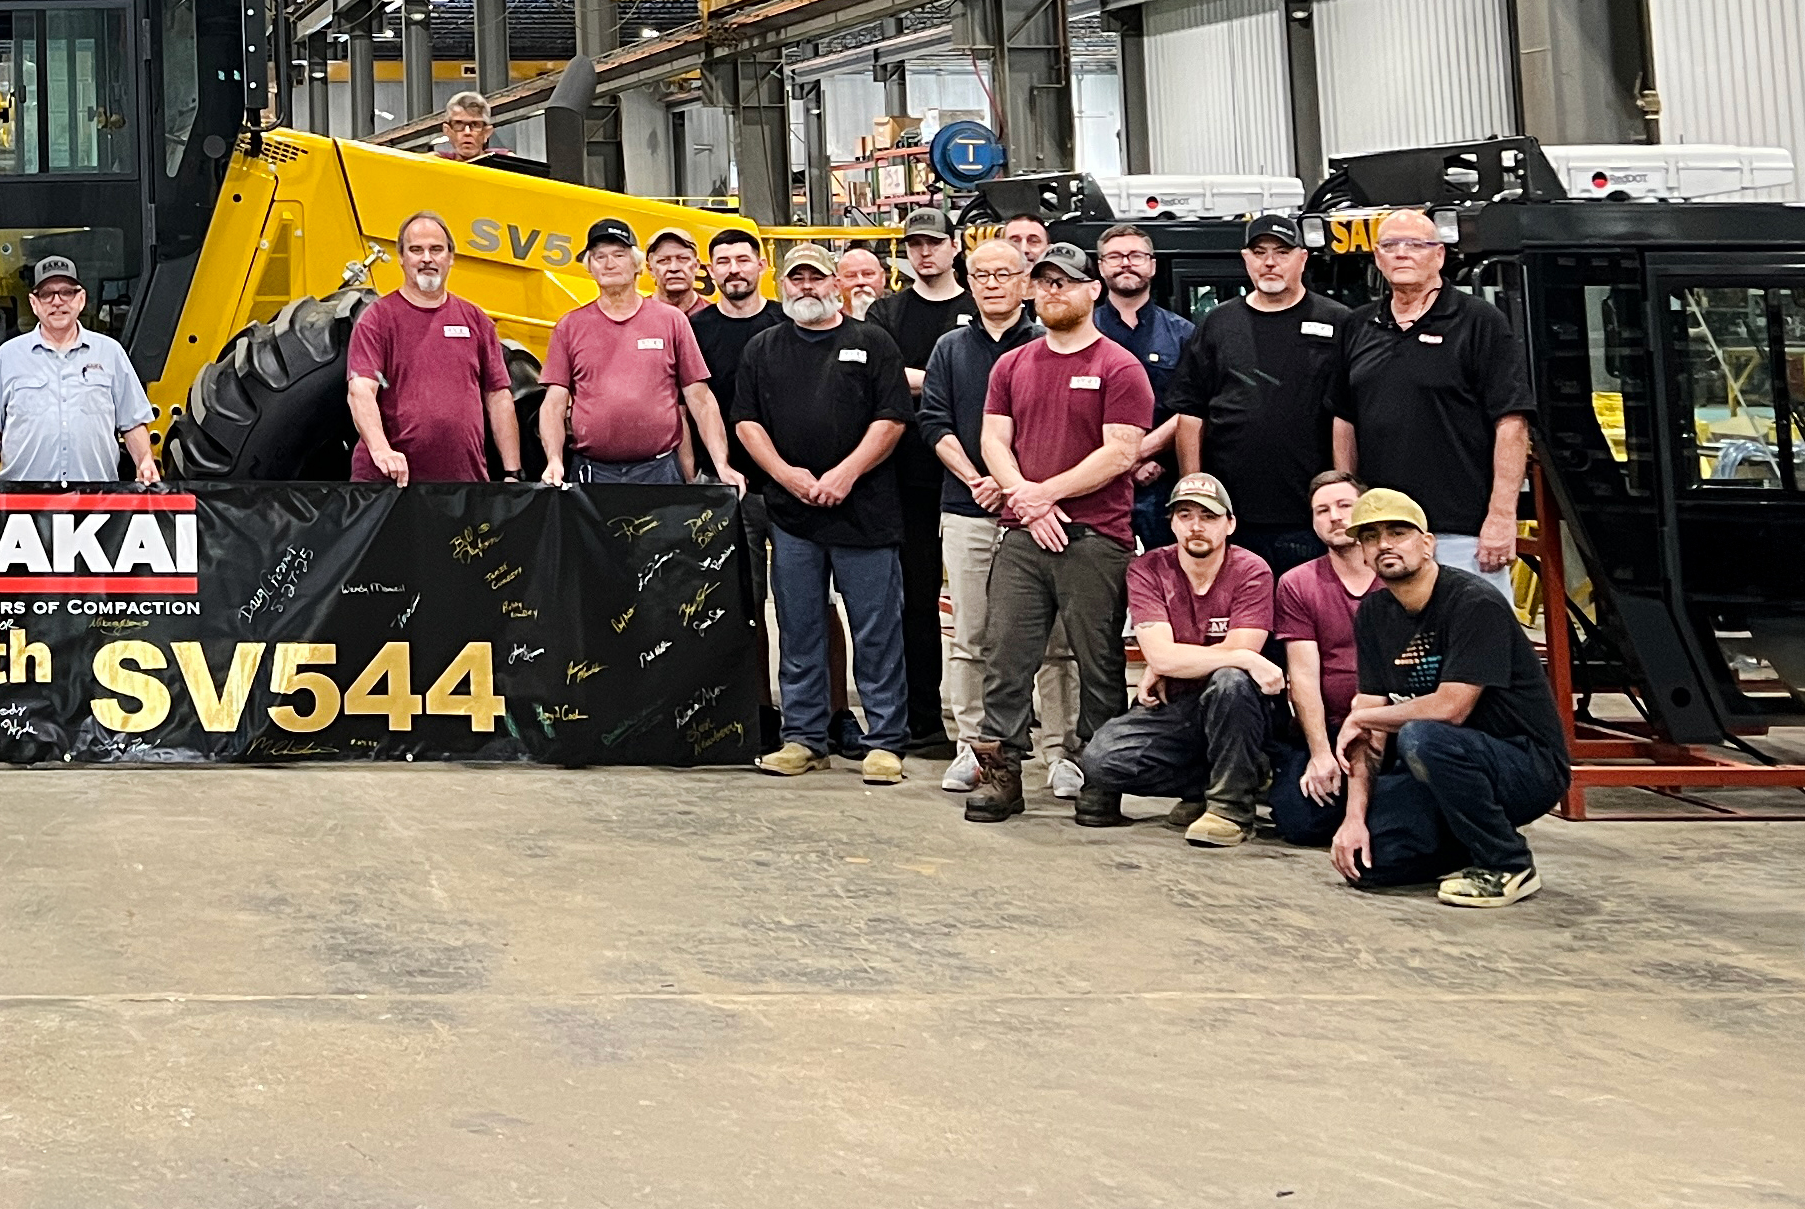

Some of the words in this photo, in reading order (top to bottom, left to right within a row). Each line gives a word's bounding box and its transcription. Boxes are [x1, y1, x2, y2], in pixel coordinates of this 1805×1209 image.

[32, 601, 60, 615] OF
[66, 599, 201, 615] COMPACTION
[90, 640, 506, 732] SV544
